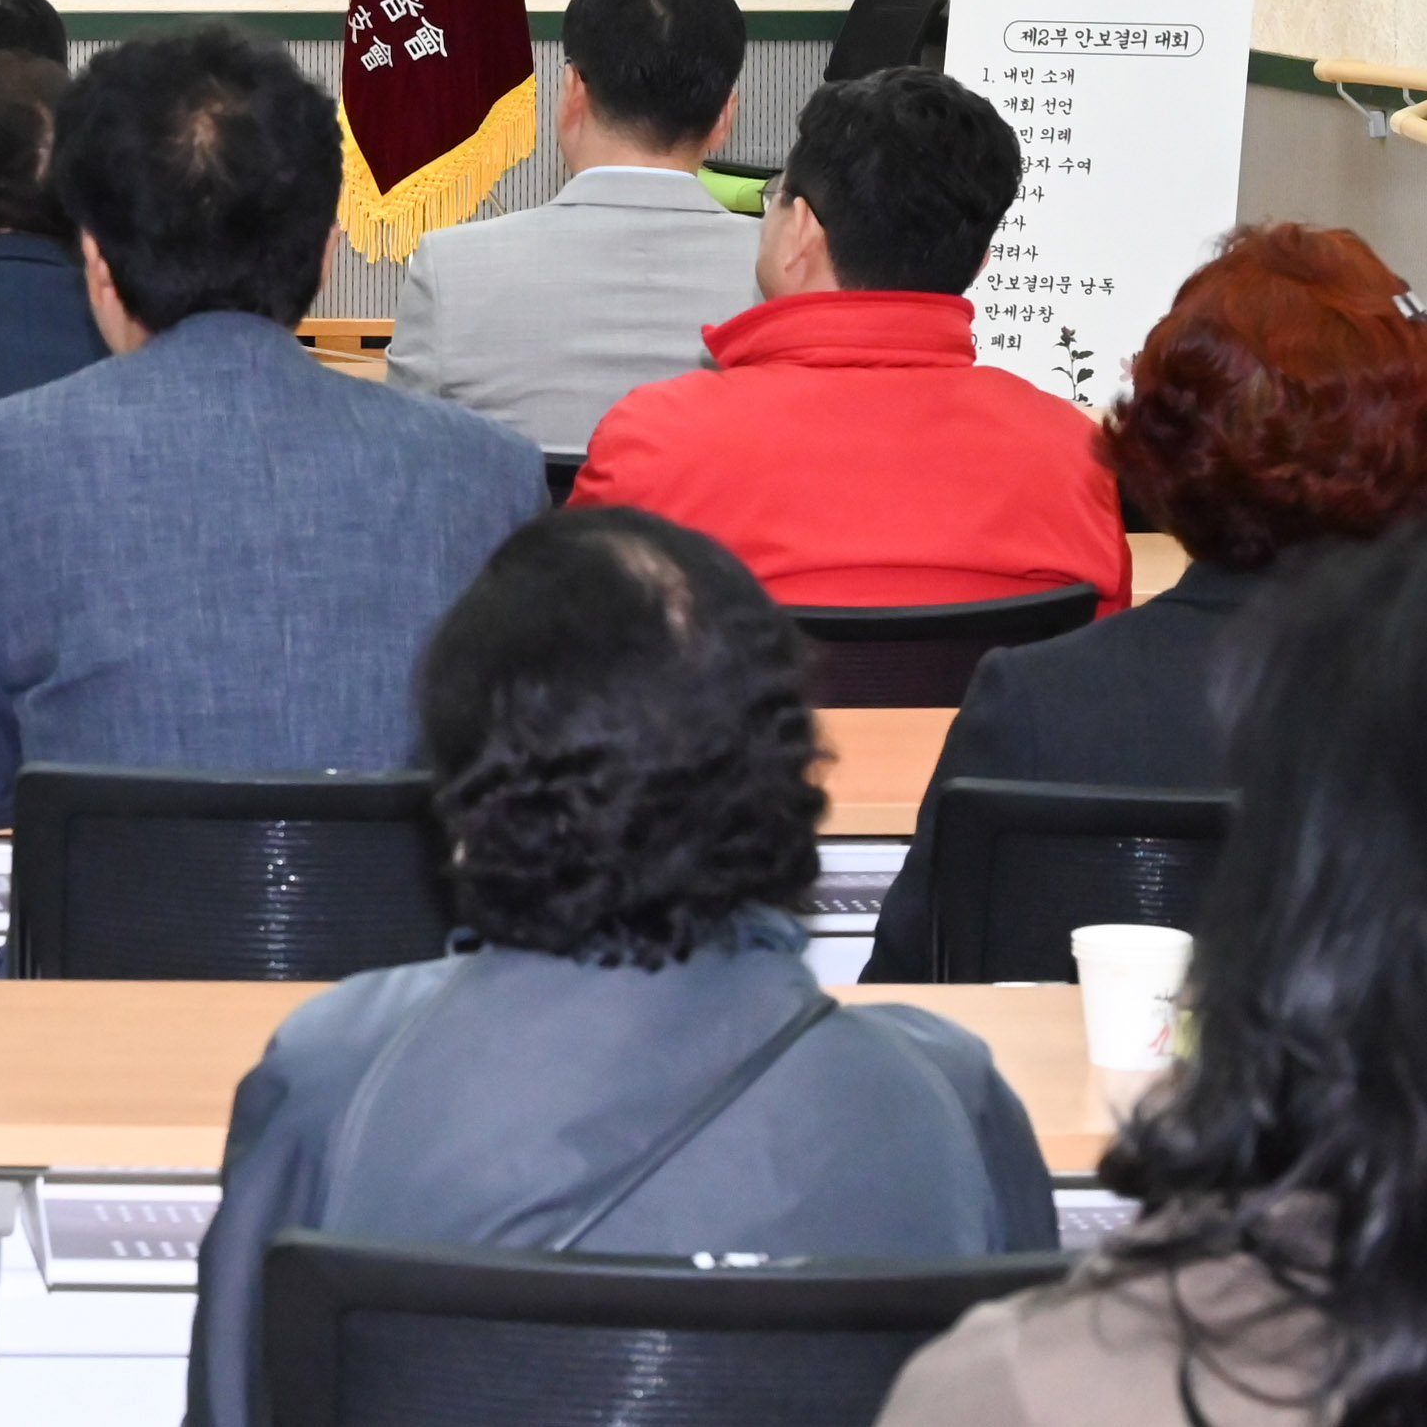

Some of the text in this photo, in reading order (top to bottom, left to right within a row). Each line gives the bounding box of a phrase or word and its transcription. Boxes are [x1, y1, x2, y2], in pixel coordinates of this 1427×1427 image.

[1021, 27, 1188, 50] 제2부 안보결의 대회
[983, 67, 1074, 85] 1. 내빈 소개
[1004, 96, 1034, 113] 개회
[1042, 98, 1072, 115] 선언
[1041, 127, 1071, 144] 의례
[1058, 157, 1091, 174] 수여
[990, 243, 1039, 262] 격려사
[988, 274, 1072, 294] 안보결의문
[1081, 277, 1114, 295] 낭독
[985, 303, 1054, 323] 만세삼창
[991, 334, 1021, 350] 폐회
